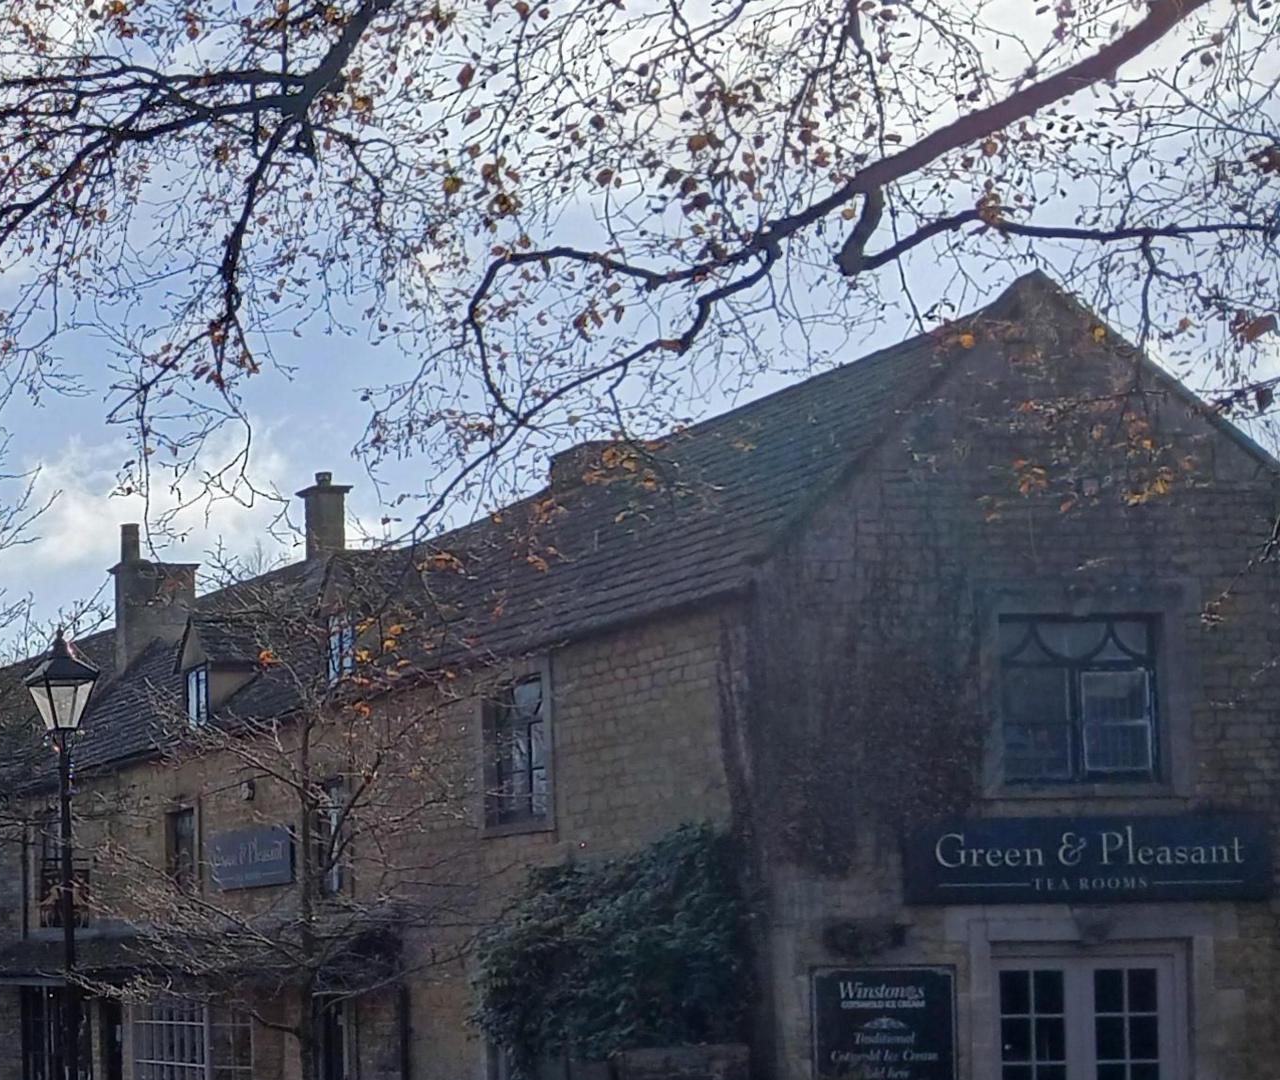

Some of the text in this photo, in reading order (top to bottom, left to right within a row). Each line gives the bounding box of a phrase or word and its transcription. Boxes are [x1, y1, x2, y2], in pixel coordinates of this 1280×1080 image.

[935, 825, 1246, 868] Green & Pleasant
[1032, 876, 1149, 891] TEA ROOMS
[853, 1031, 916, 1045] Traditional
[902, 1048, 939, 1061] Cream
